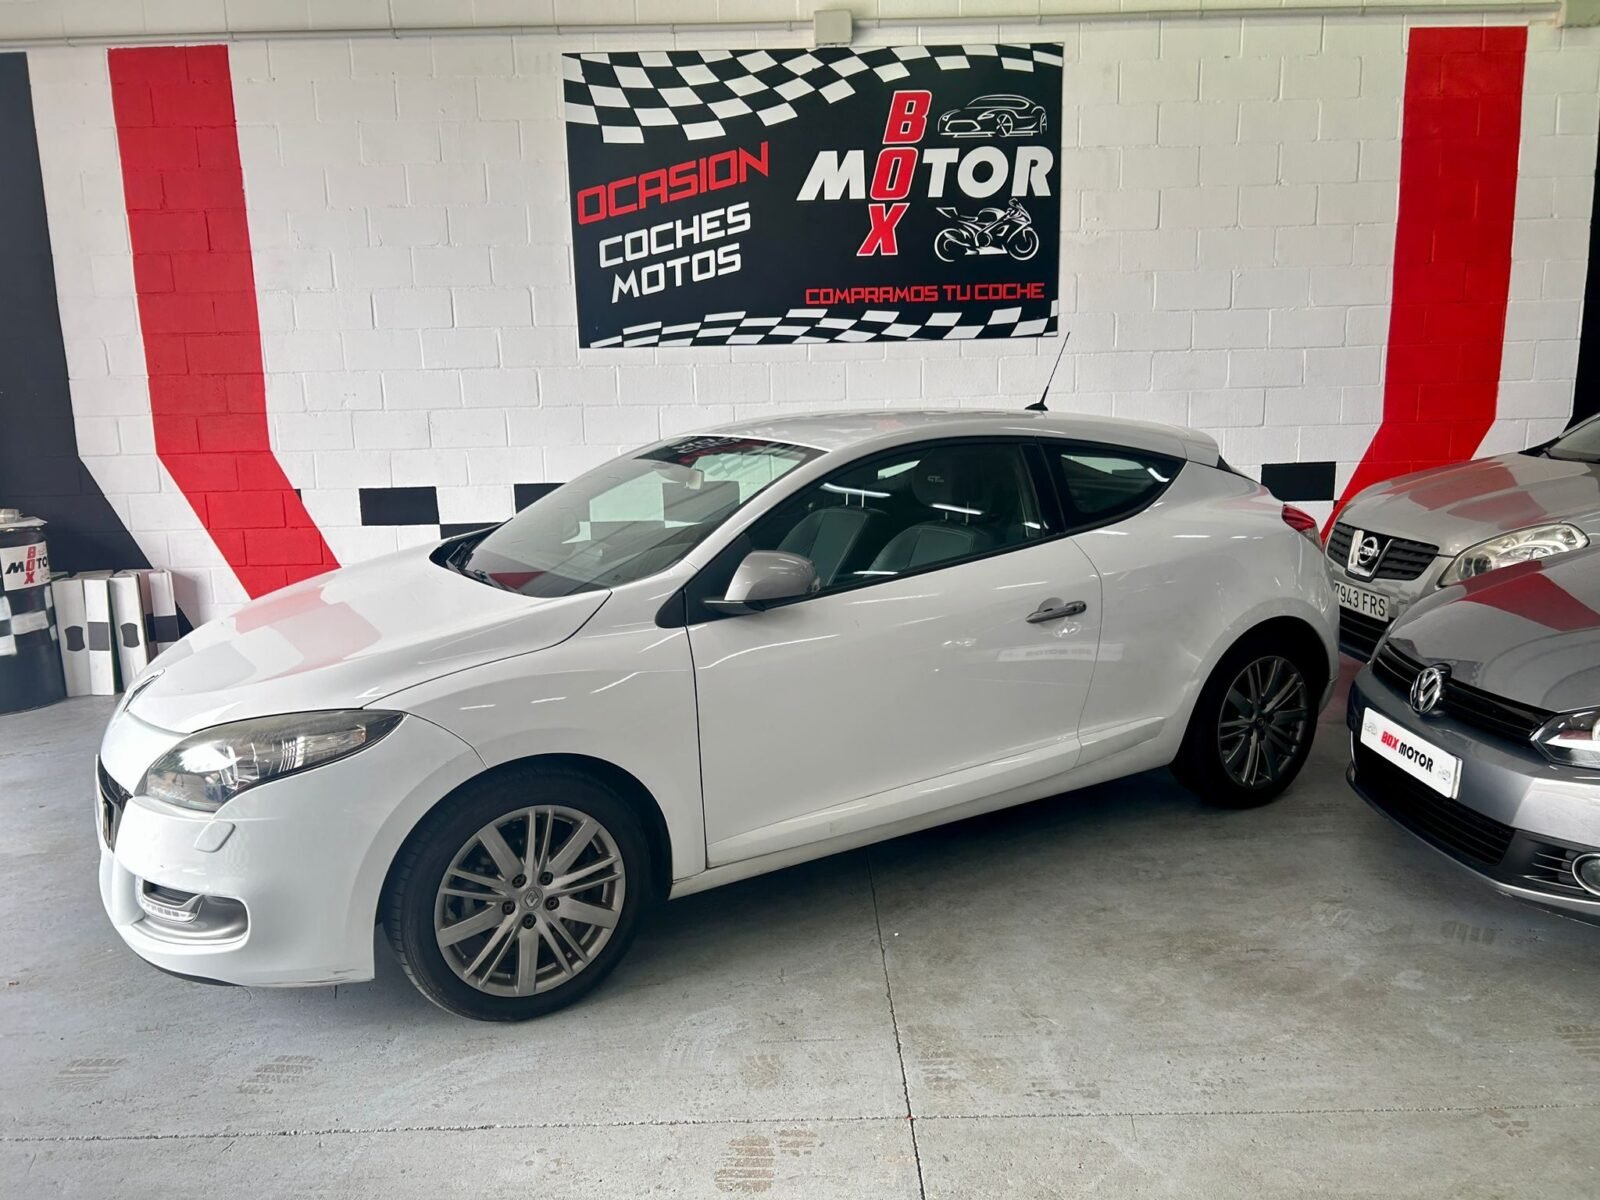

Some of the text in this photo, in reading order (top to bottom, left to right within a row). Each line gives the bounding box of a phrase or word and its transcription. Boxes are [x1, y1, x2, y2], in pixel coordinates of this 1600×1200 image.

[576, 141, 770, 226] OCASION
[796, 145, 1055, 201] MOTOR
[857, 89, 933, 257] BOX
[598, 201, 751, 269] COCHES
[611, 242, 742, 304] MOTOS
[805, 282, 1045, 305] COMPRAMOS TU COCHE
[5, 556, 48, 575] MOTO
[24, 546, 37, 585] BOX
[1334, 582, 1386, 617] 7943 FRS
[1380, 730, 1434, 773] BOX MOTOR
